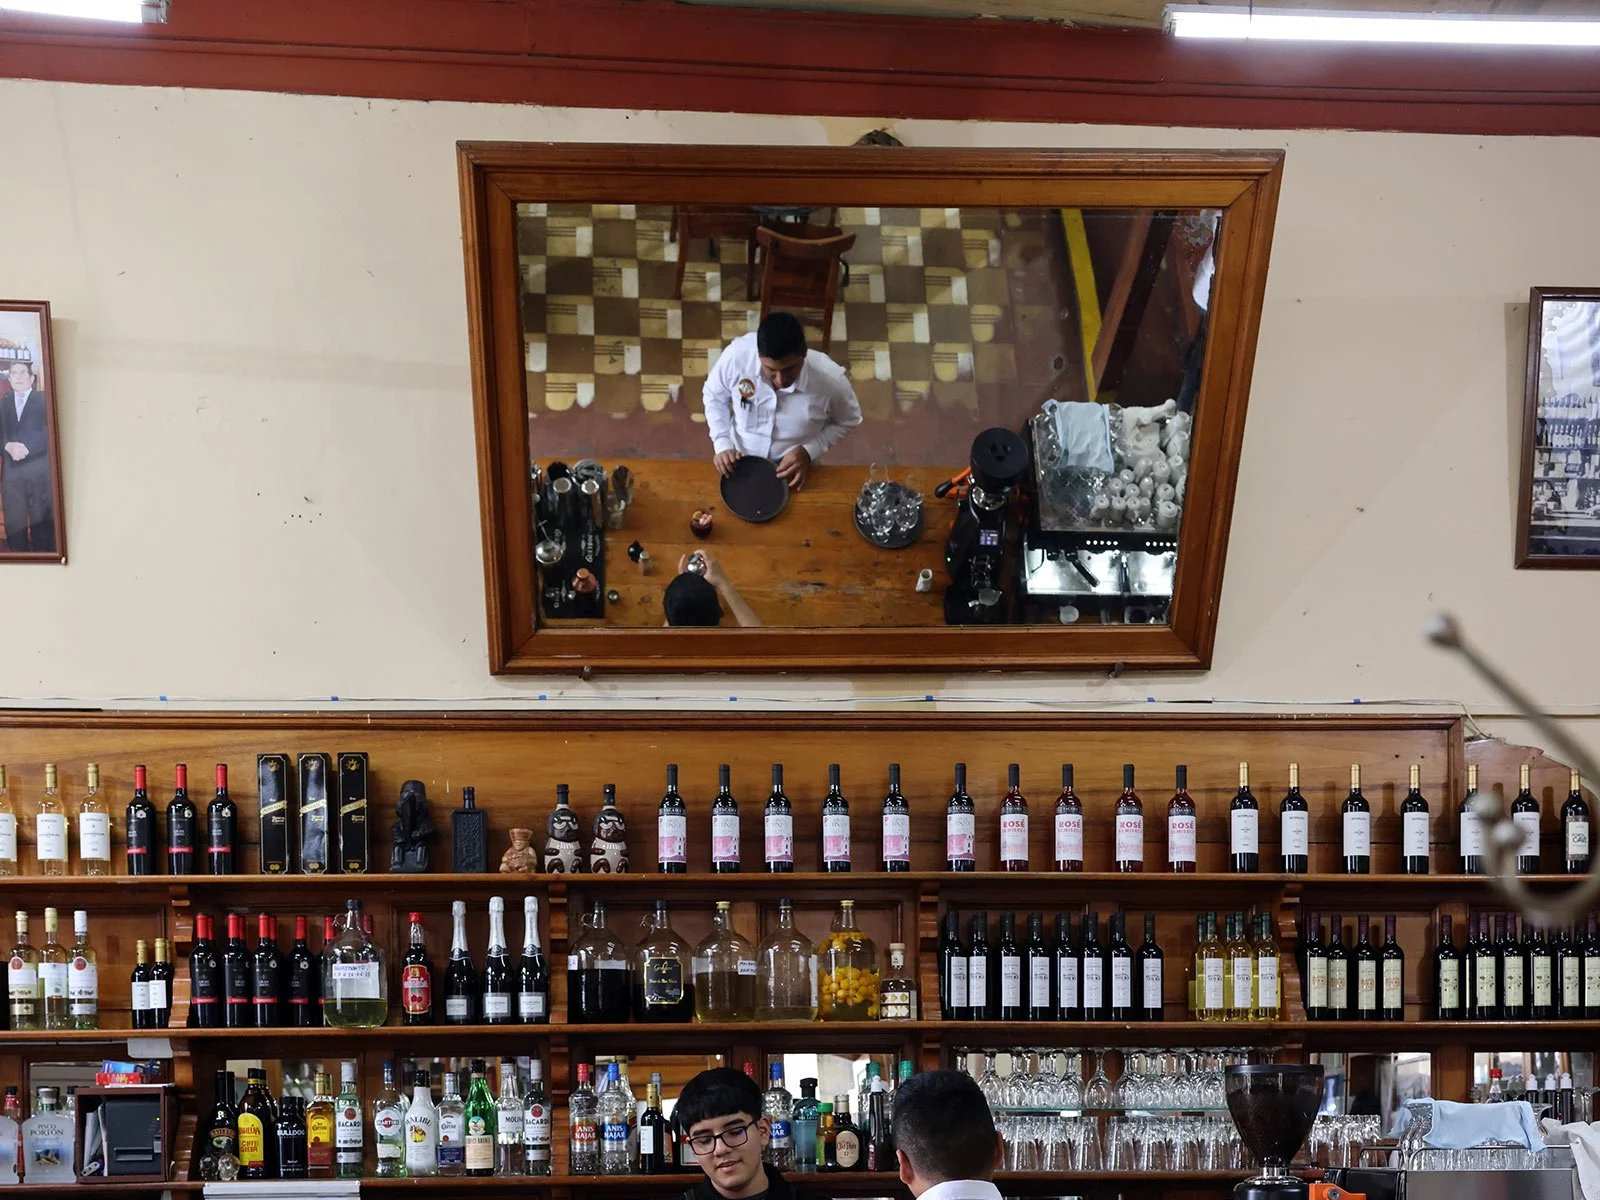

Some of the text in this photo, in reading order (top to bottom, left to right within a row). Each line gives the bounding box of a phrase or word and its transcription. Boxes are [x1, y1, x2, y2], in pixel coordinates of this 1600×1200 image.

[1003, 819, 1025, 828] ROSÉ
[1058, 819, 1081, 828] ROSÉ
[1120, 819, 1142, 828] ROSÉ
[1171, 820, 1194, 829] ROSÉ
[406, 1116, 433, 1126] MALIBU
[770, 1129, 785, 1137] JAR
